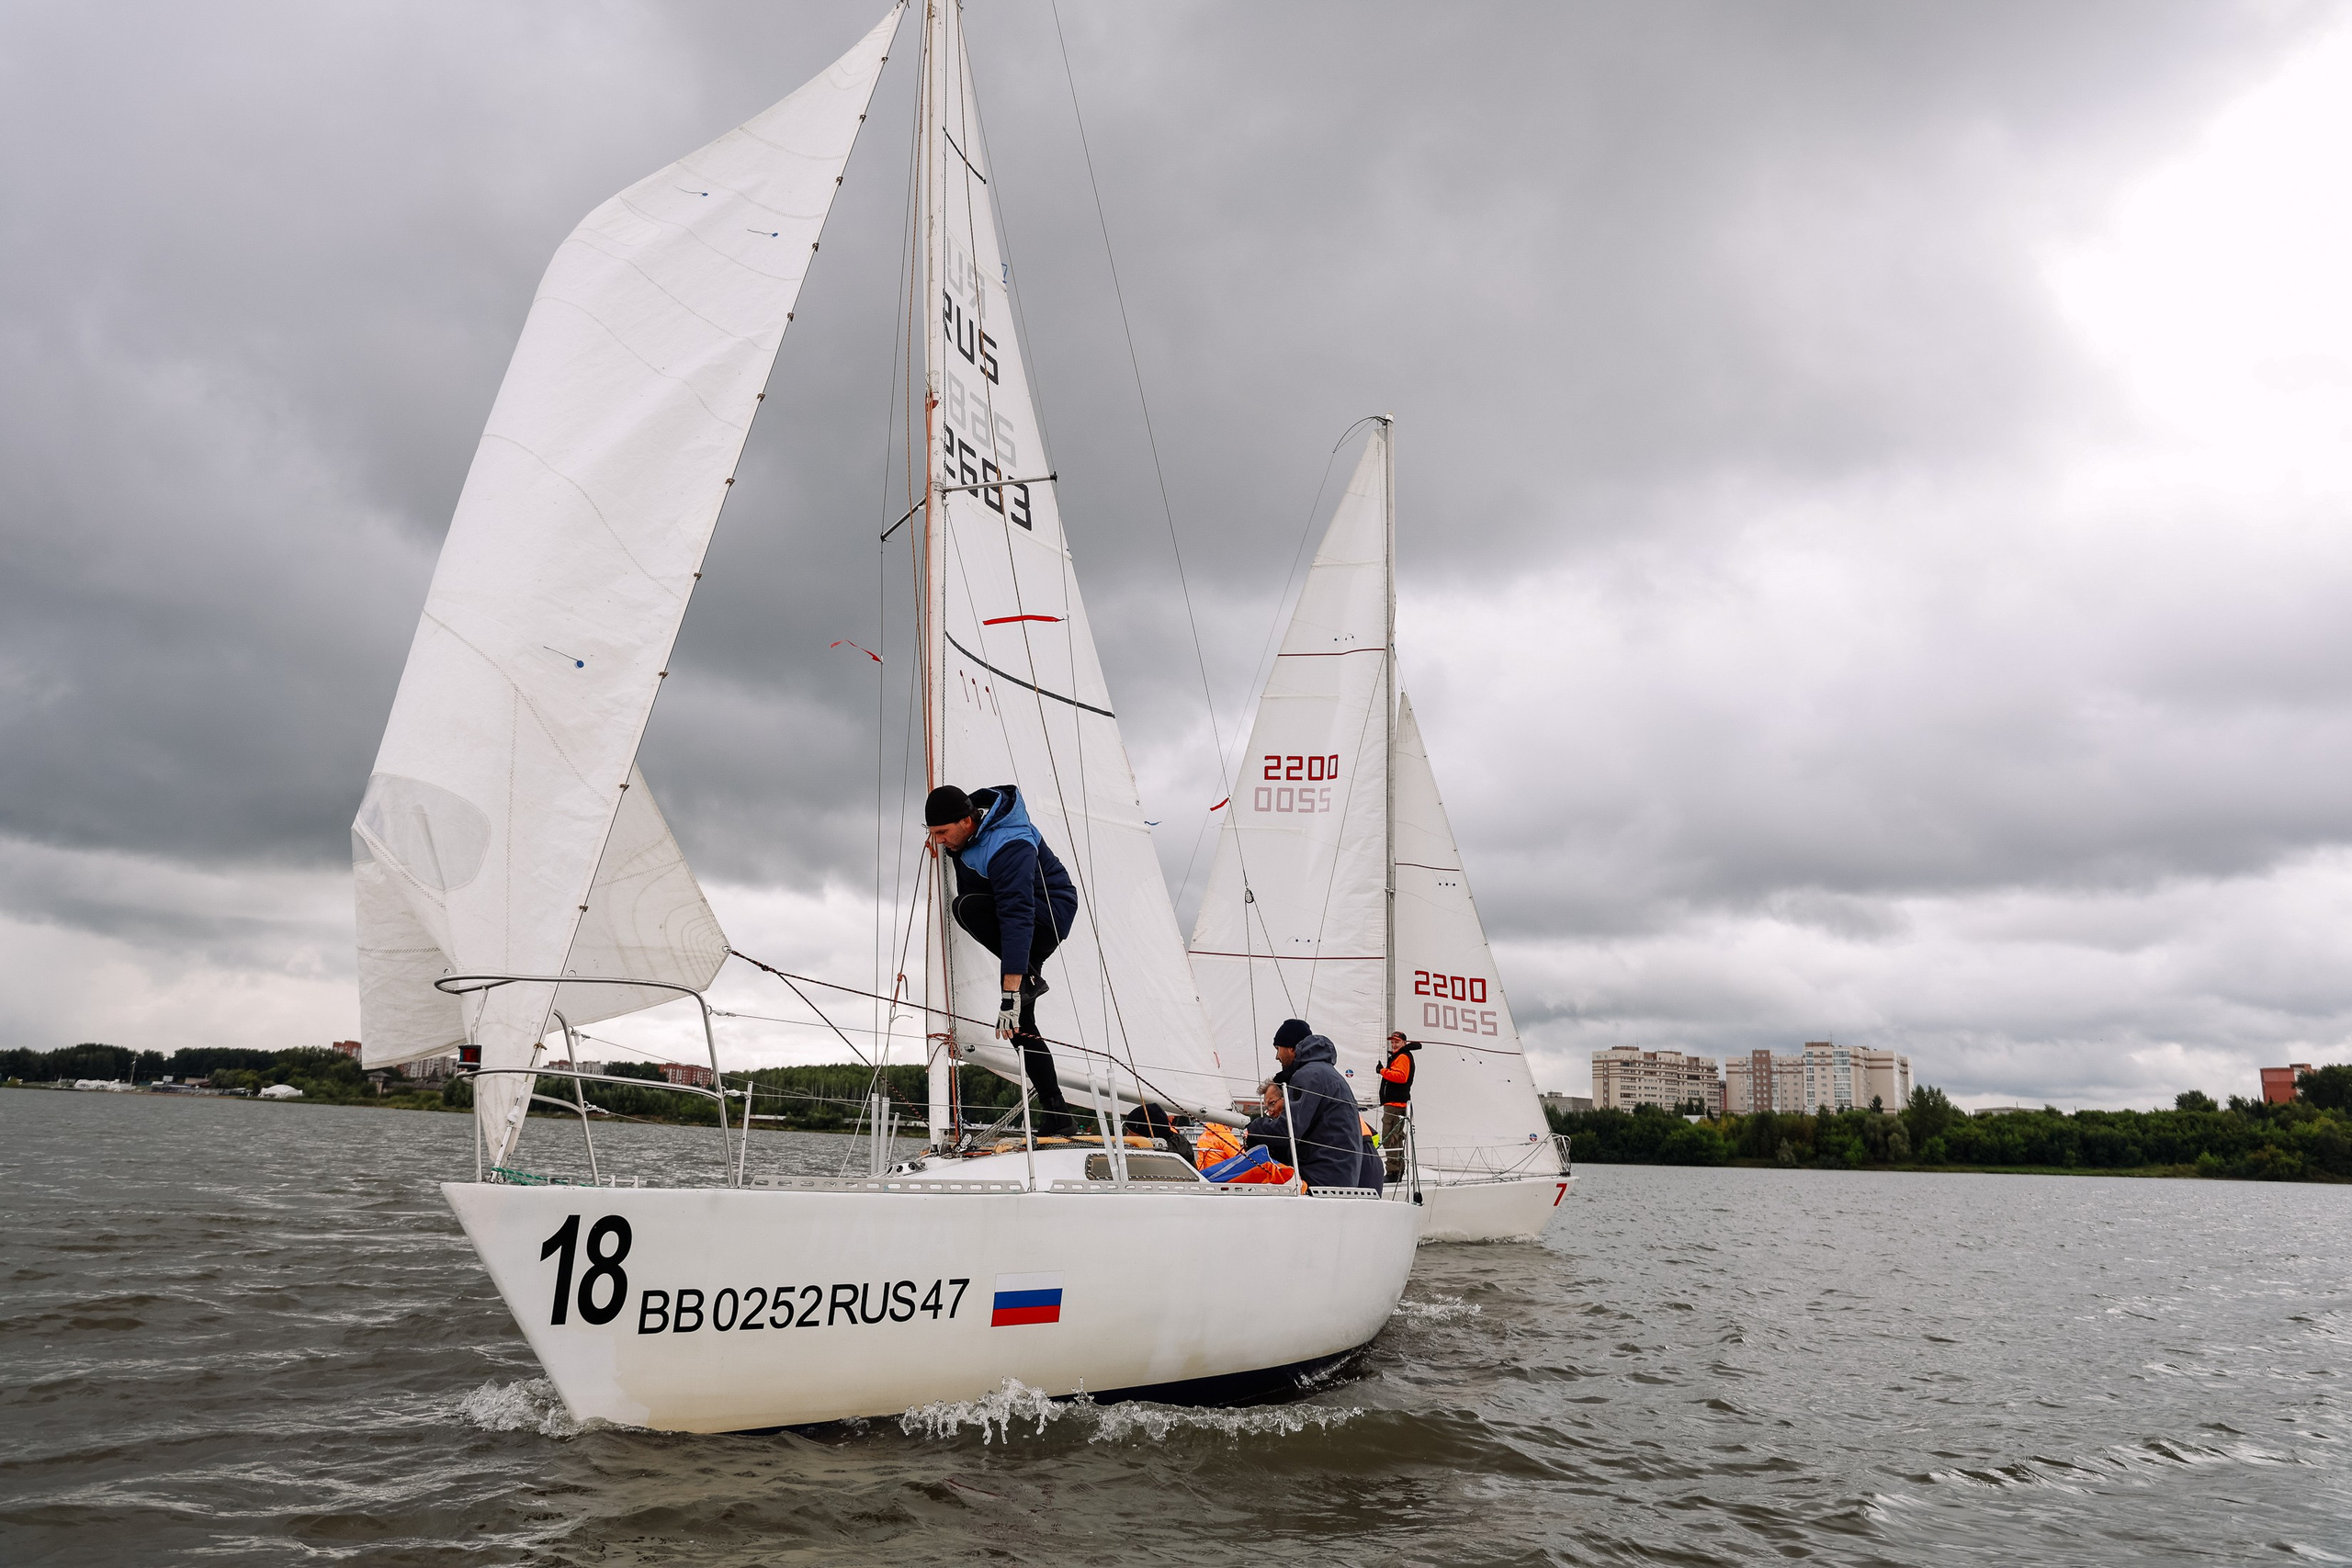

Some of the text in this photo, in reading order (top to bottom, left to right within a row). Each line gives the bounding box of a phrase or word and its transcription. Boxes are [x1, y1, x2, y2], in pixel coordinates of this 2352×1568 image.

[1263, 754, 1339, 781] 2200
[1414, 970, 1487, 1003] 2200
[1553, 1183, 1567, 1206] 7
[539, 1214, 632, 1325] 18
